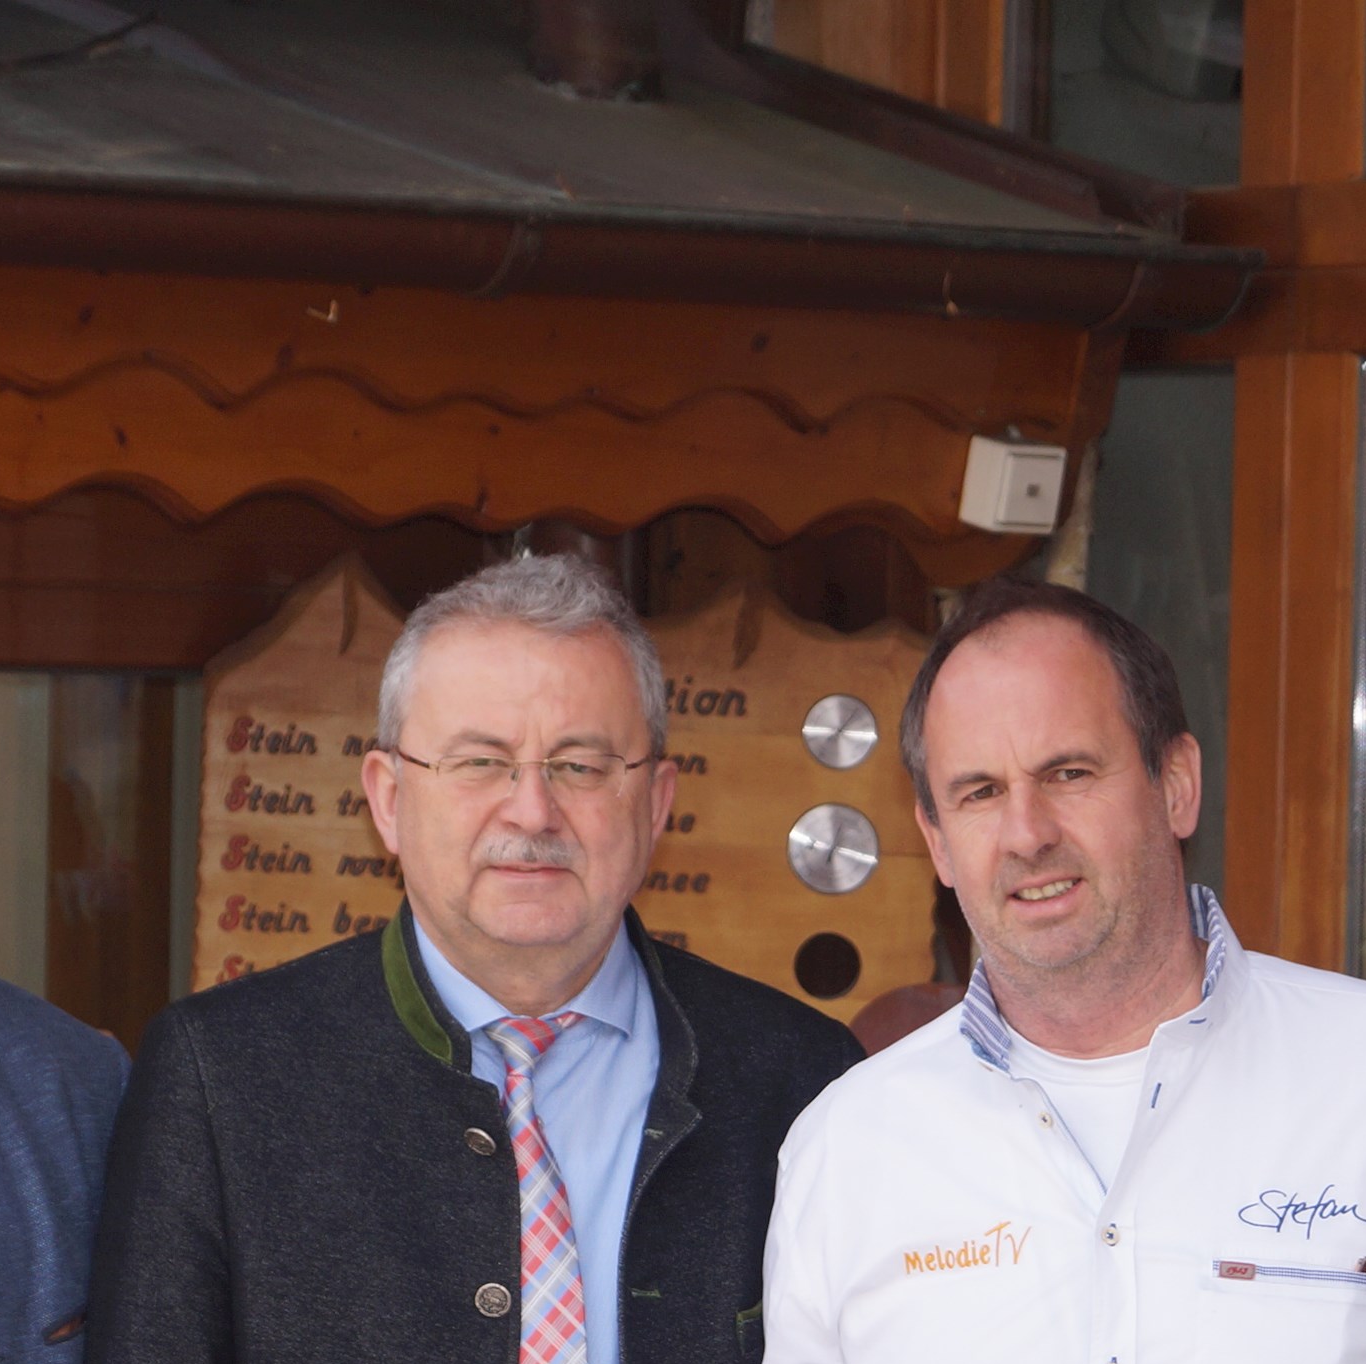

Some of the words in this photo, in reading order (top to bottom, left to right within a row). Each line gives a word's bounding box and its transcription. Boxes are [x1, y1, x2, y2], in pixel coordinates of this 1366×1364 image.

[226, 716, 318, 756] Stein
[225, 774, 315, 816] Stein
[221, 834, 312, 874] Stein
[218, 894, 310, 934] Stein
